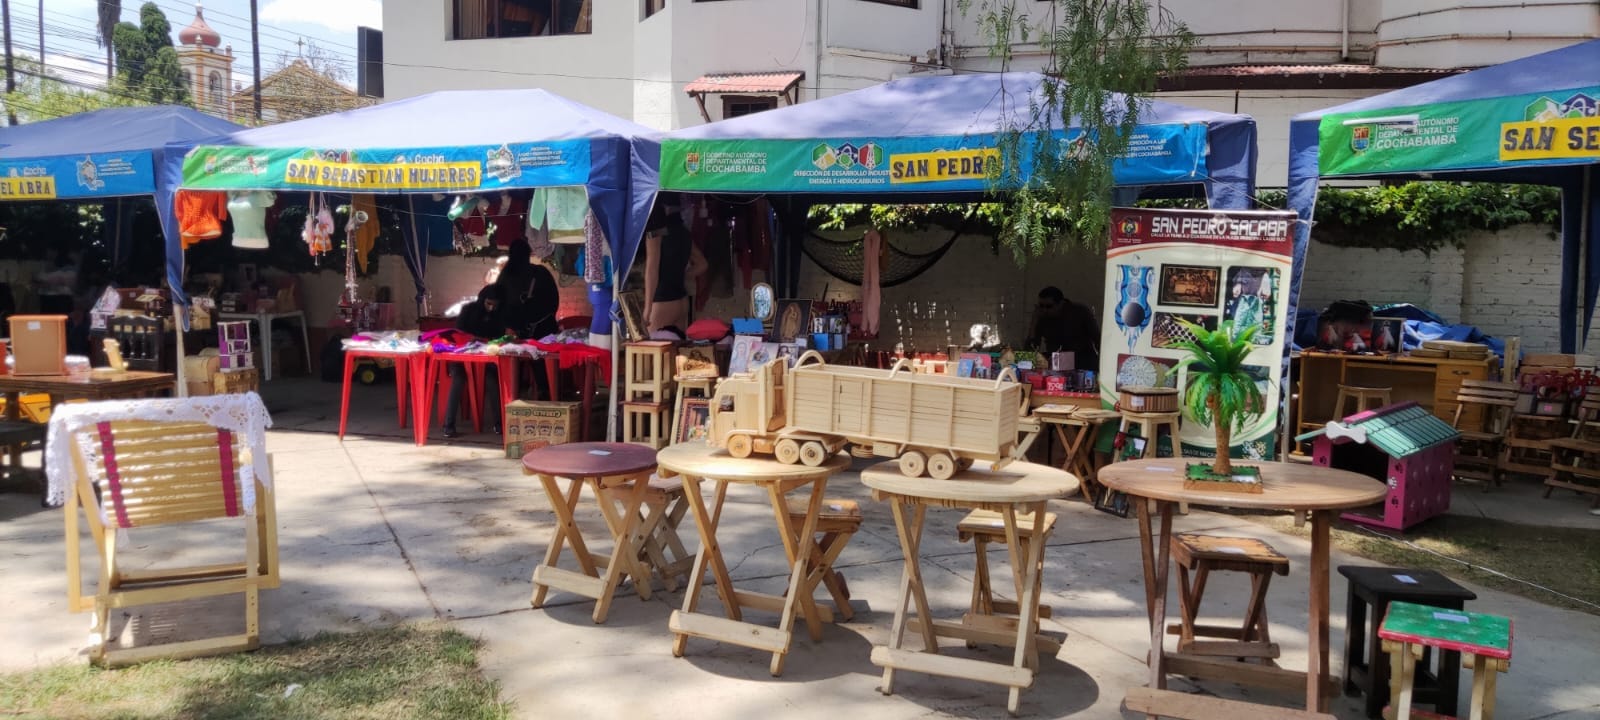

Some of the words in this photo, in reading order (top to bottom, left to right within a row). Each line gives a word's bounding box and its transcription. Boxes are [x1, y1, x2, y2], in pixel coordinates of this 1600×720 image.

[1447, 125, 1458, 133] DE
[1376, 135, 1457, 149] COCHABAMBA
[1503, 126, 1555, 150] SAN
[1568, 126, 1600, 150] SE
[288, 162, 320, 180] SAN
[321, 165, 403, 184] SEBASTIAN
[409, 166, 476, 183] MUJERES
[706, 164, 767, 173] COCHABAMBA
[892, 158, 929, 180] SAN
[937, 154, 1001, 176] PEDRO
[1, 182, 14, 195] EL
[19, 181, 50, 195] ABRA
[1151, 216, 1179, 233] SAN
[1181, 217, 1227, 235] PEDRO
[1230, 219, 1288, 237] SACABA
